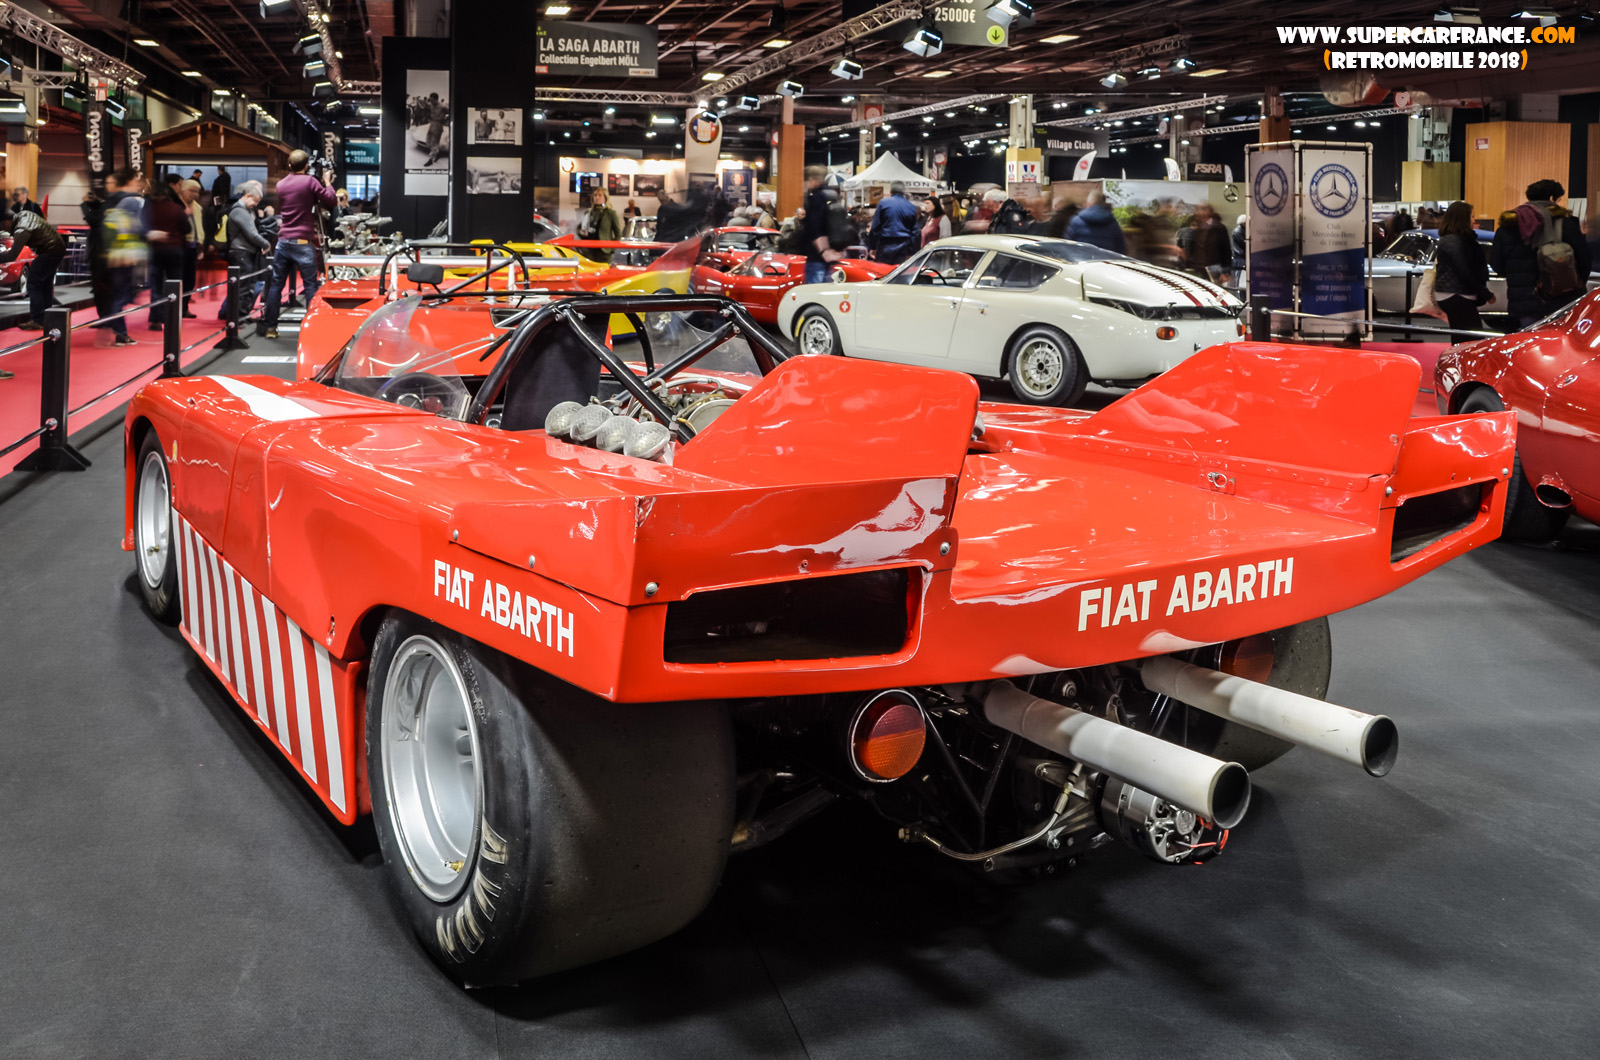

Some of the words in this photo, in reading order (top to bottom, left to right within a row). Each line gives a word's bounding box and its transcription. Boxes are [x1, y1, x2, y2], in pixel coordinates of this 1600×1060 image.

[934, 7, 976, 24] 25000€
[540, 37, 555, 51] LA
[558, 38, 590, 53] SAGA
[593, 39, 640, 54] ABARTH
[539, 53, 579, 65] Collection
[580, 54, 618, 68] Engelbert
[618, 54, 640, 67] MÖLL
[1046, 139, 1073, 151] Village
[1074, 140, 1095, 150] Clubs
[1077, 579, 1158, 632] FIAT
[1165, 557, 1295, 616] ABARTH
[434, 559, 475, 611] FIAT
[480, 578, 575, 658] ABARTH
